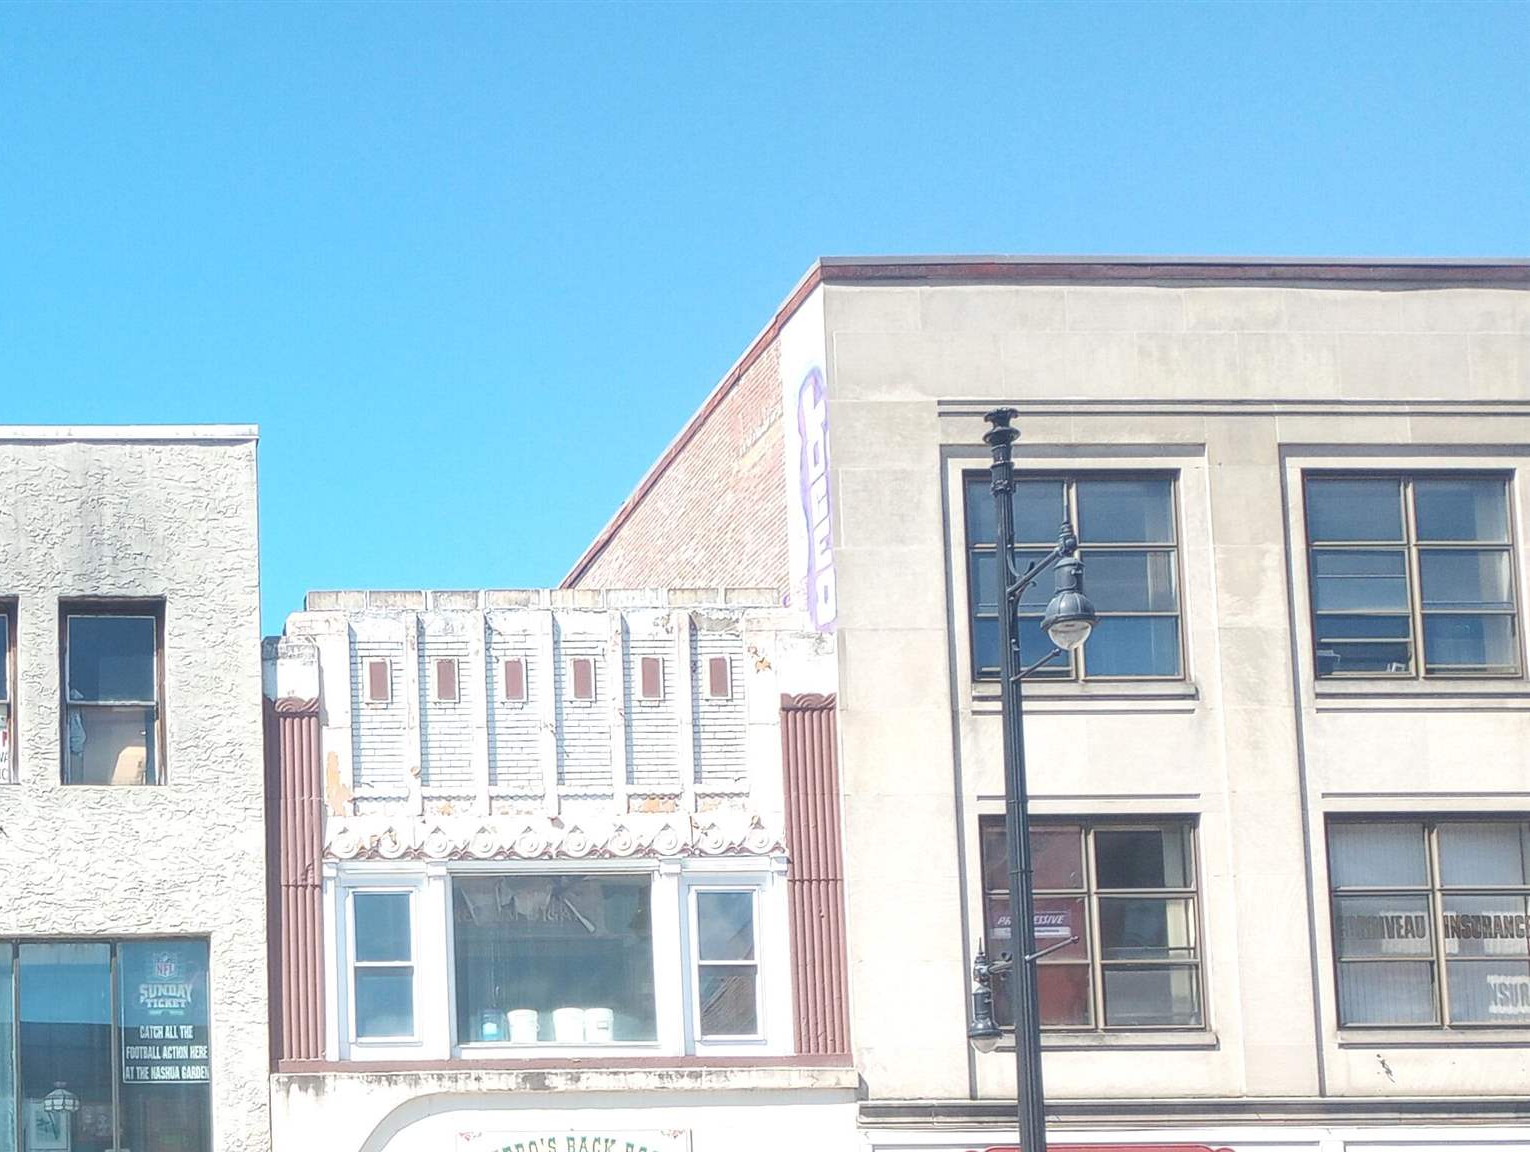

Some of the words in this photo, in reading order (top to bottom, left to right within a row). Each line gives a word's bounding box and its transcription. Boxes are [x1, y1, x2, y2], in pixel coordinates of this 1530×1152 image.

[997, 914, 1064, 925] PRESSIVE
[139, 983, 192, 1003] SUNDAY
[145, 998, 186, 1008] TICKET
[139, 1025, 163, 1039] CATCH
[164, 1025, 179, 1039] ALL
[180, 1025, 194, 1039] THE
[126, 1045, 161, 1059] FOOTBALL
[162, 1045, 188, 1059] ACTION
[190, 1045, 208, 1059] HERE
[125, 1066, 134, 1079] AT
[136, 1066, 150, 1079] THE
[151, 1066, 180, 1079] NASHUA
